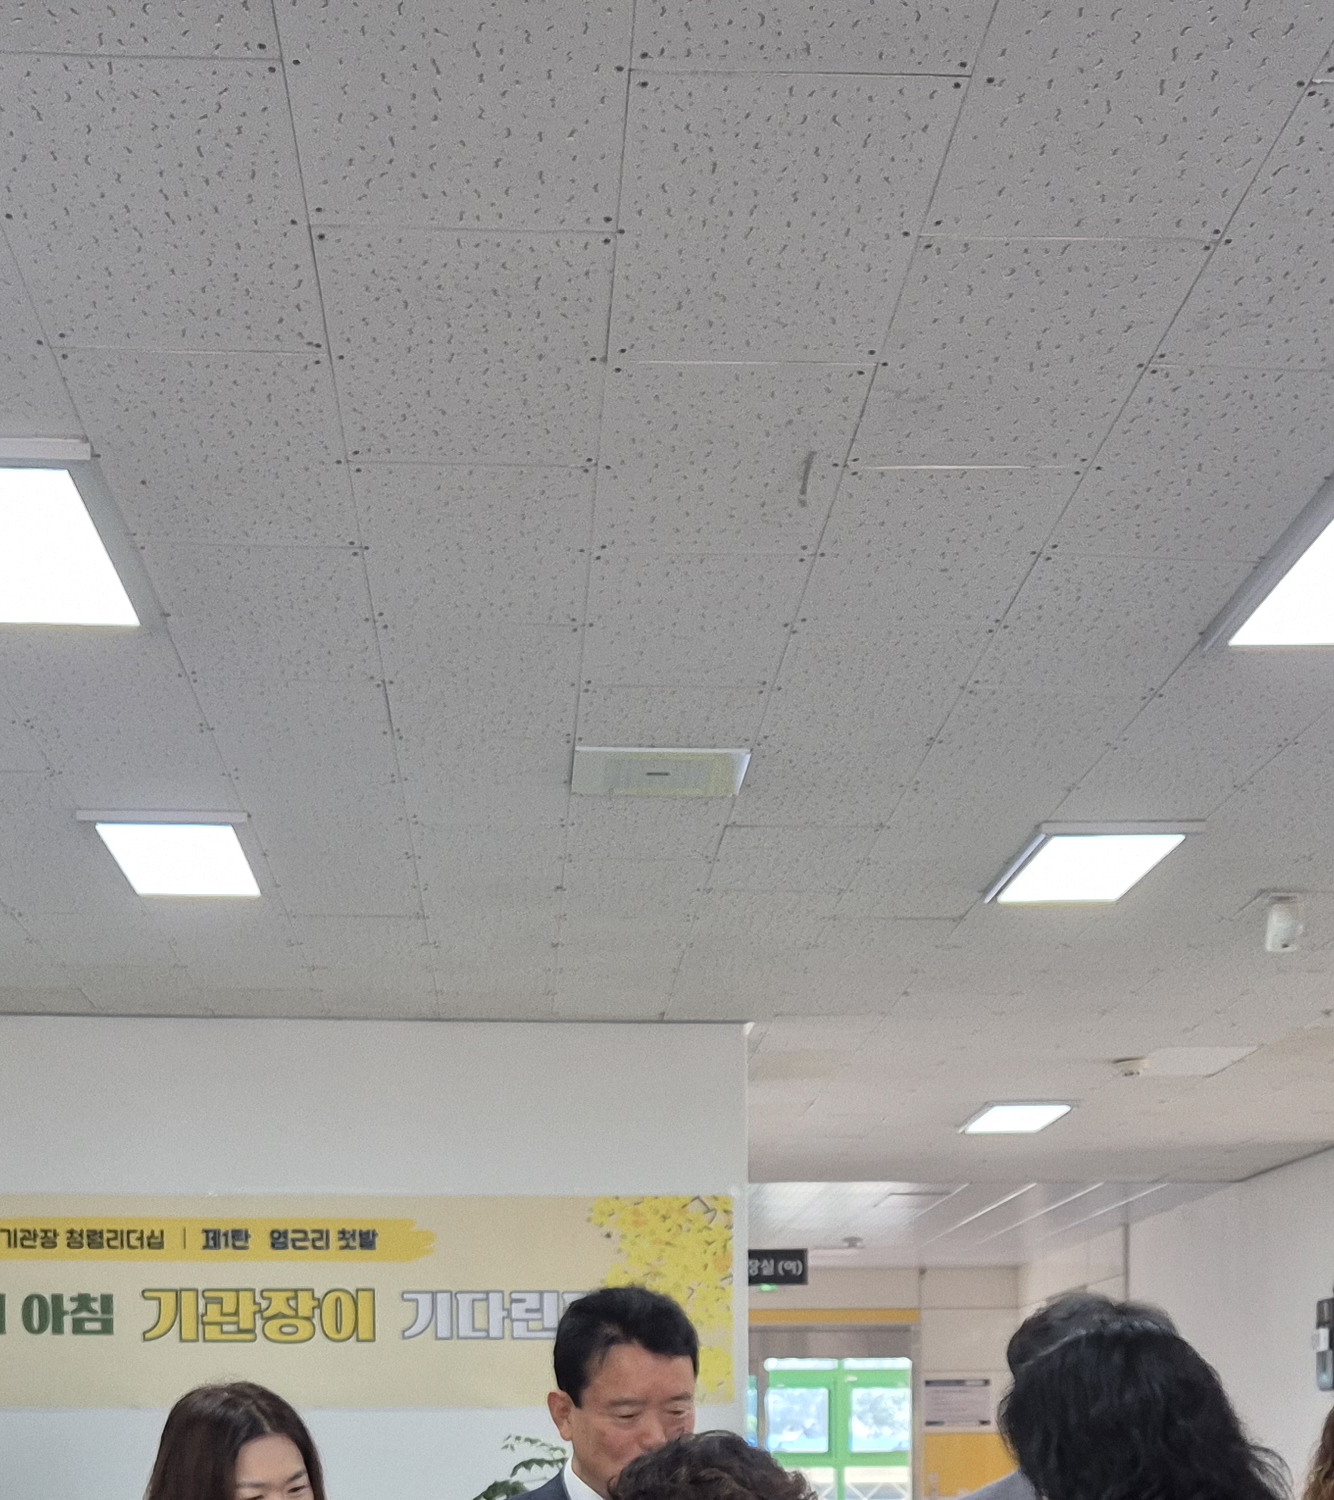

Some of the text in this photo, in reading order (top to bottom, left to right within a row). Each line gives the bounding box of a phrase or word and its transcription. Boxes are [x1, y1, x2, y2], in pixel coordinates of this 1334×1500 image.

[0, 1227, 59, 1250] 기관장
[65, 1227, 166, 1251] 청렴리더십
[20, 1292, 115, 1336] 아침
[140, 1287, 376, 1344] 기관장이
[400, 1289, 585, 1341] 기다린
